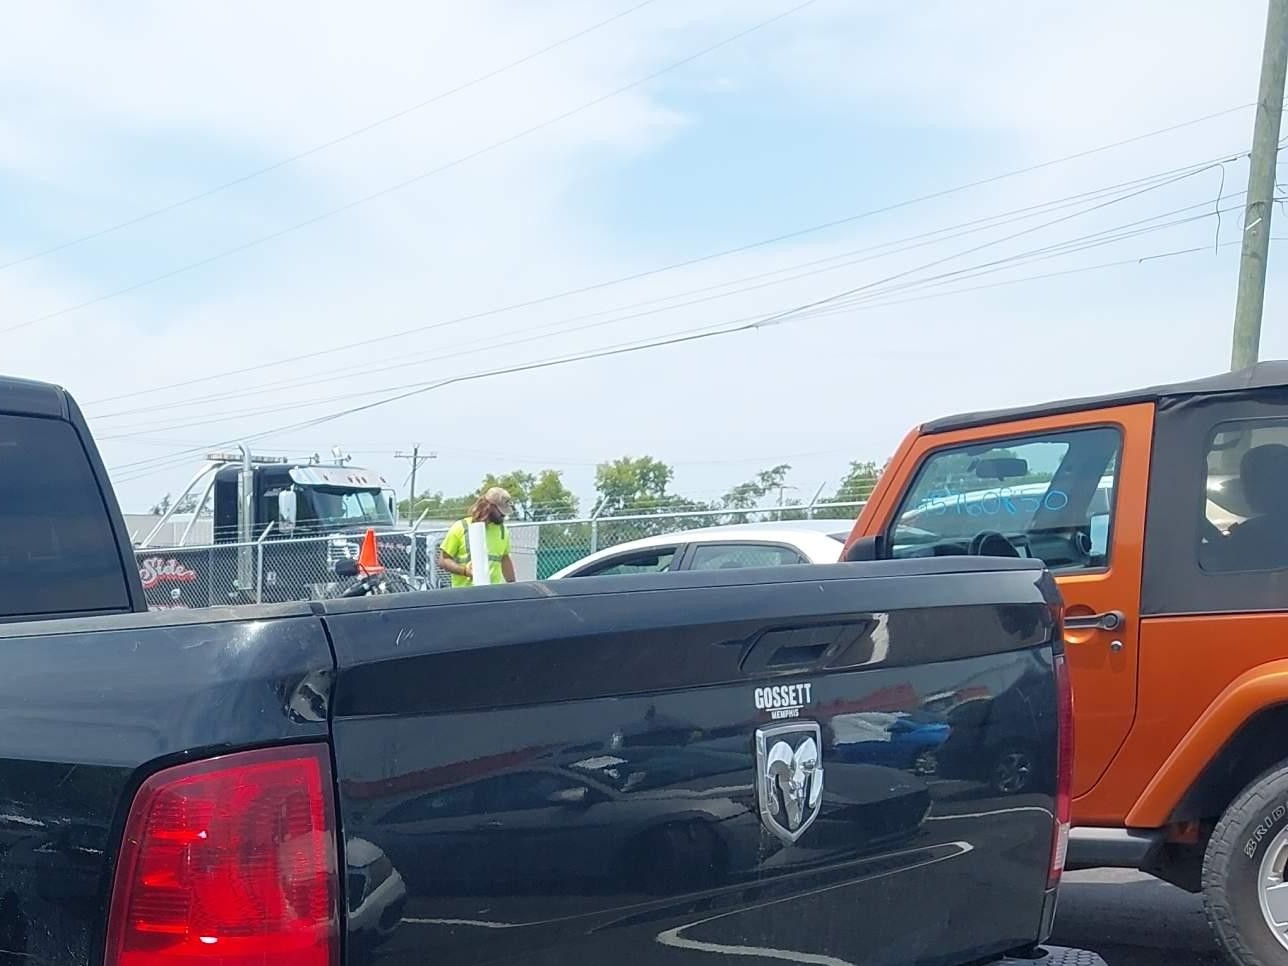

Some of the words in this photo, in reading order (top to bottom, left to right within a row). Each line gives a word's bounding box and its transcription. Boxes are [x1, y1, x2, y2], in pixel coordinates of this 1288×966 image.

[754, 683, 811, 708] GOSSETT
[771, 709, 799, 719] MEMPHIS
[1244, 801, 1288, 858] BRID
